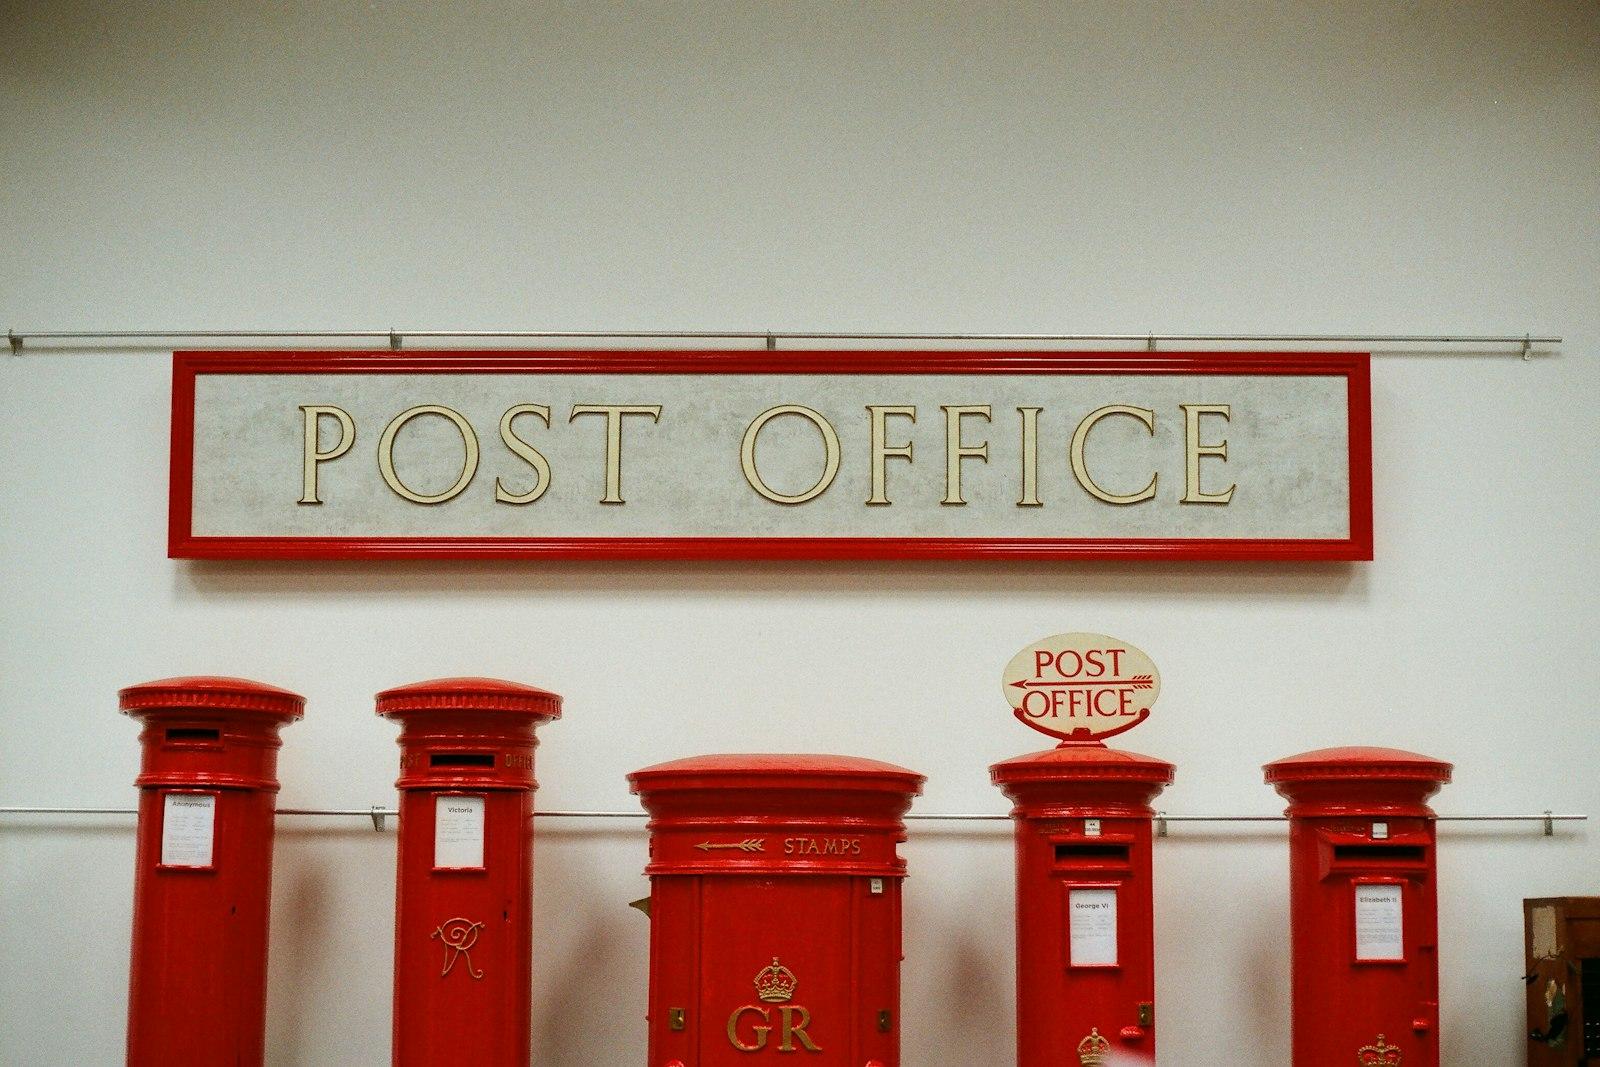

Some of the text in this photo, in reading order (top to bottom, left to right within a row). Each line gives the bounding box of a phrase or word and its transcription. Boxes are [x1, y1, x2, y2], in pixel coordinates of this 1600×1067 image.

[296, 402, 1237, 507] POST OFFICE
[1034, 649, 1126, 678] POST
[1022, 688, 1138, 718] OFFICE
[784, 837, 861, 854] STAMPS
[1075, 902, 1100, 910] George
[727, 1005, 822, 1051] GR
